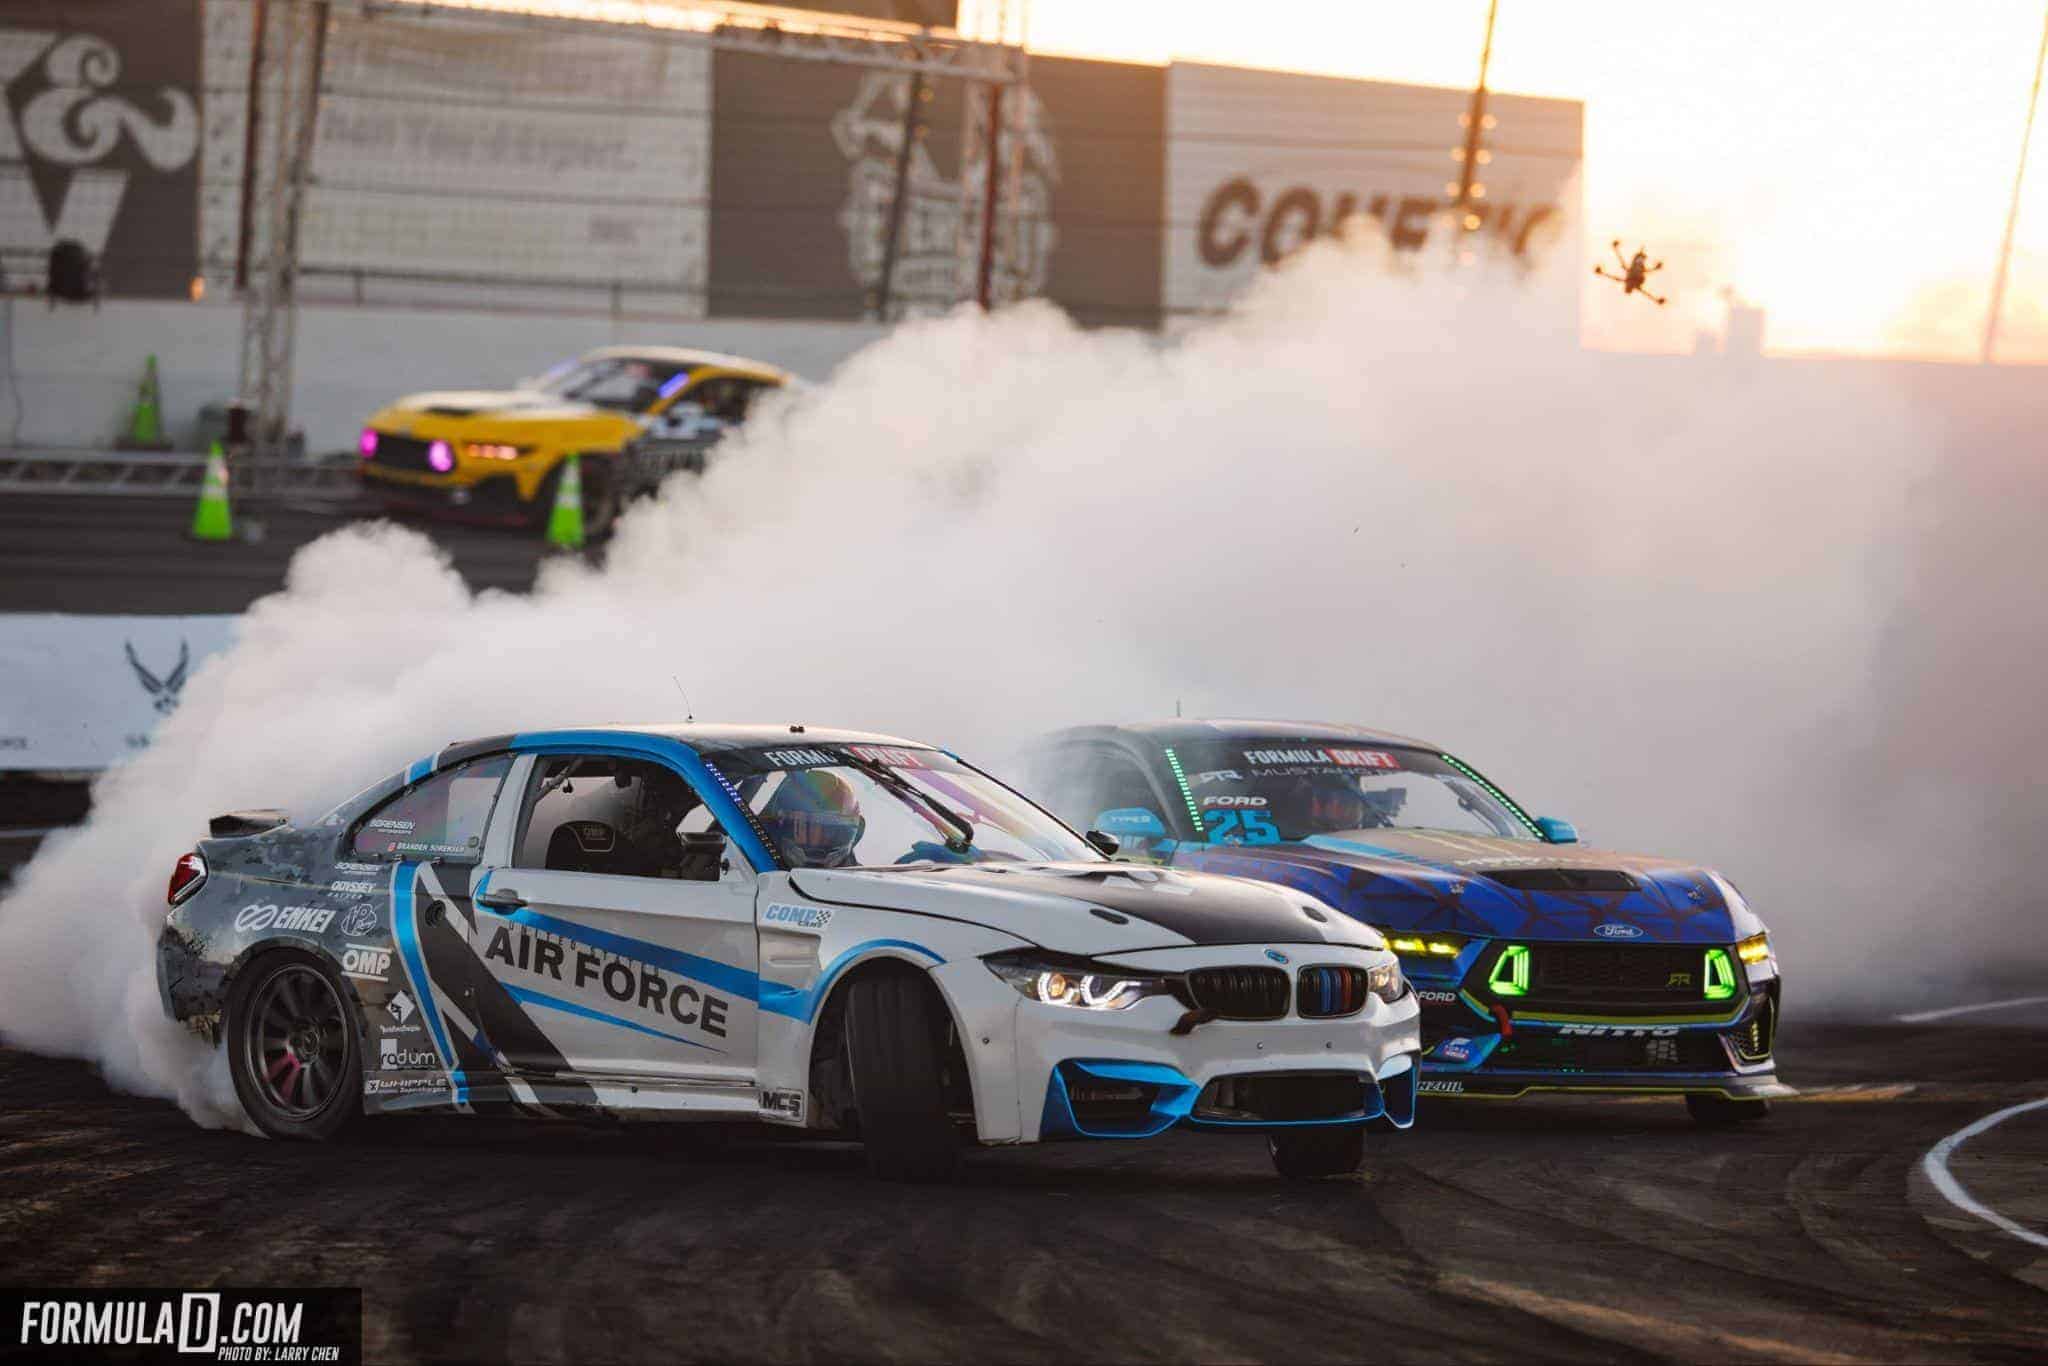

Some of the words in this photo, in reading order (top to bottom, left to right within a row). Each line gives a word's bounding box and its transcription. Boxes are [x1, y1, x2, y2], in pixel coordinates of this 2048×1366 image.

[1243, 750, 1332, 765] FORMULA
[1334, 751, 1396, 767] DRIFT
[1202, 796, 1267, 807] FORD
[1203, 807, 1281, 846] 25
[271, 906, 337, 934] ENKEI
[765, 904, 817, 922] COMP
[342, 950, 391, 976] OMP
[485, 926, 564, 981] AIR
[574, 951, 729, 1038] FORCE
[1417, 991, 1457, 1001] FORD
[1559, 1023, 1681, 1037] NITTO
[380, 1078, 448, 1089] WHIPPLE
[762, 1091, 801, 1114] MCS
